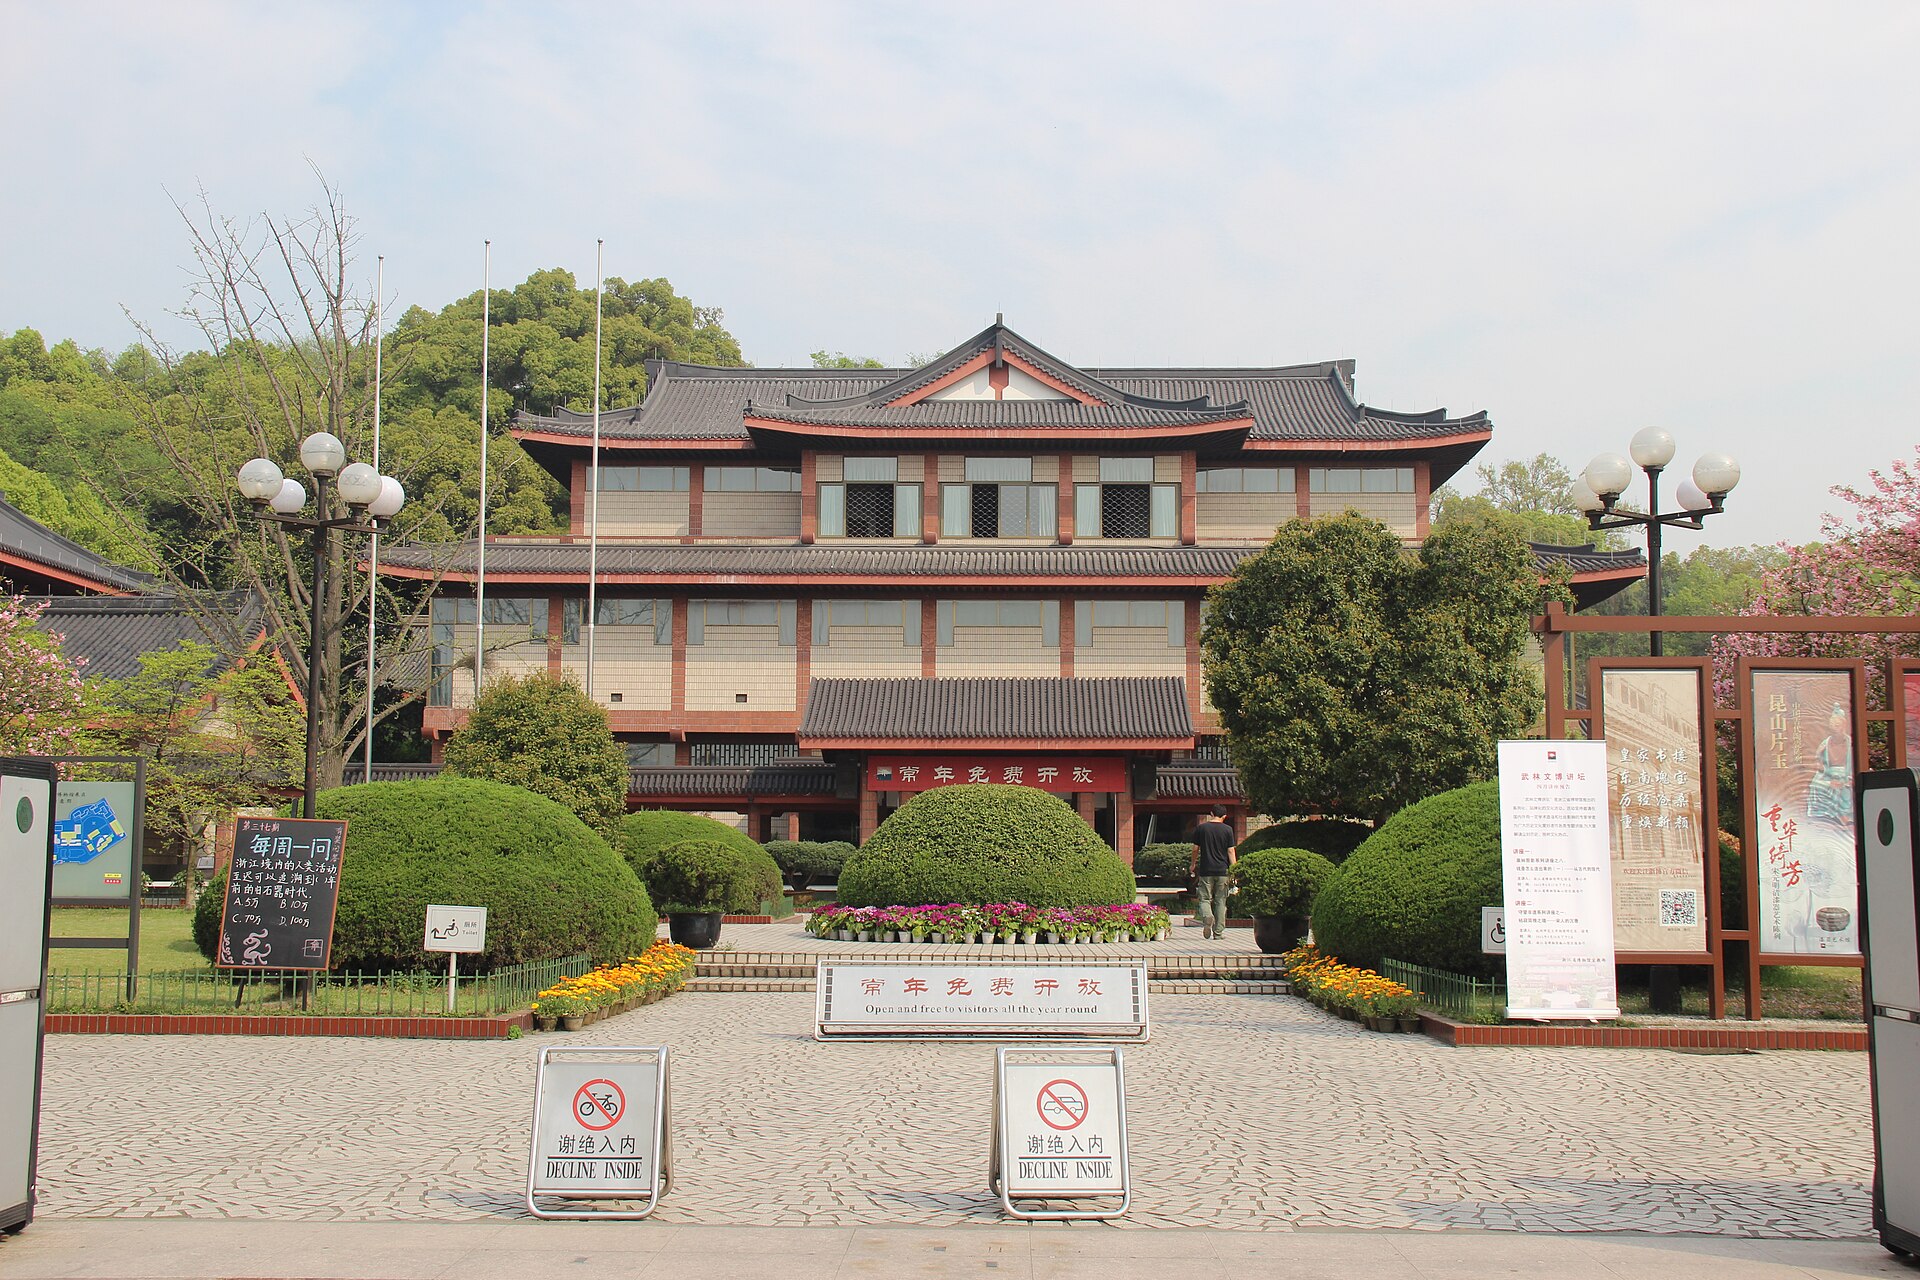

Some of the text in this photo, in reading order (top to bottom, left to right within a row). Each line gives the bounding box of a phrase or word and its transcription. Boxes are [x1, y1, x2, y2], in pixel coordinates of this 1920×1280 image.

[1769, 693, 1788, 769] 昆山片玉
[1620, 747, 1688, 763] 皇家书楼
[899, 765, 1093, 784] 常年免费开放
[1521, 773, 1586, 781] 武林文博讲坛
[1620, 769, 1688, 785] 东南瑰宝
[1619, 792, 1689, 807] 历经沧桑
[242, 820, 280, 832] 第三十七期
[1620, 814, 1689, 829] 重焕新颜
[250, 834, 332, 861] 每周一问
[860, 976, 1103, 996] 常年免费开放
[865, 1004, 1098, 1016] Open and free to visitors all the year round
[558, 1134, 635, 1154] 谢绝入内
[1027, 1134, 1103, 1154] 谢绝入内
[546, 1161, 642, 1179] DECLINE INSIDE
[1018, 1161, 1113, 1179] DECLINE INSIDE
